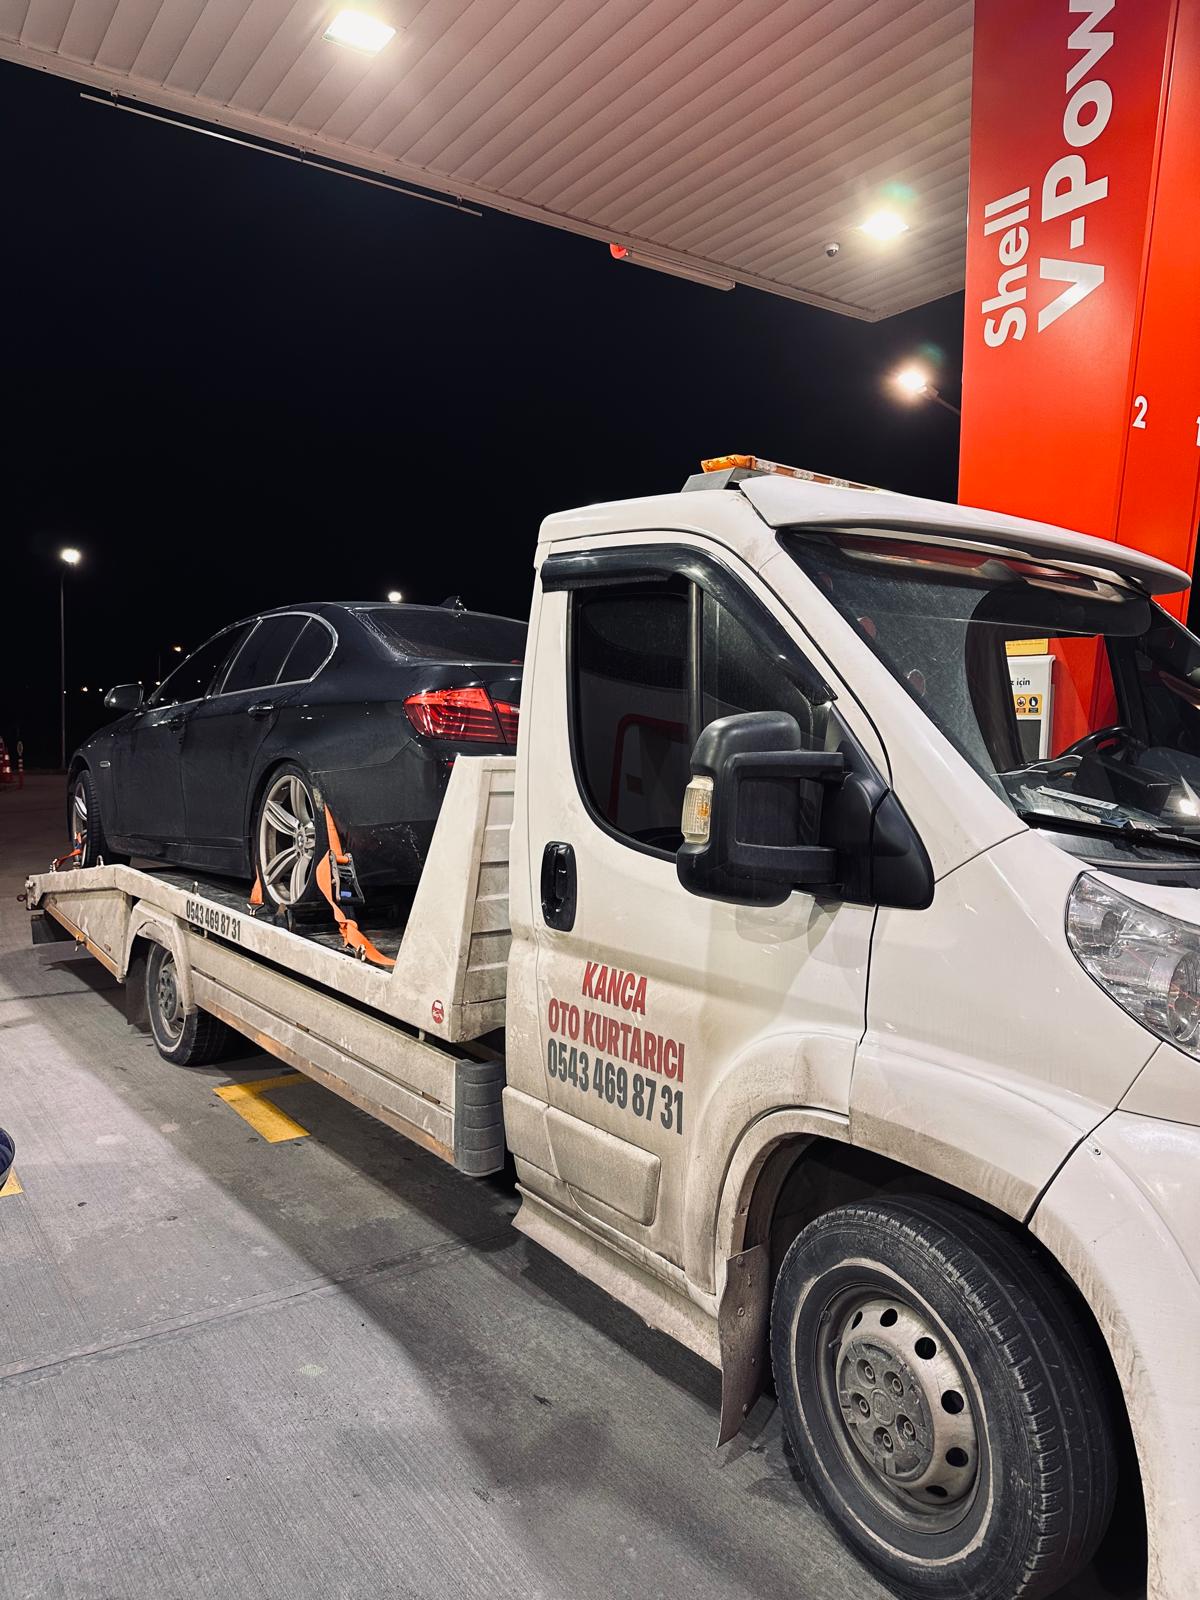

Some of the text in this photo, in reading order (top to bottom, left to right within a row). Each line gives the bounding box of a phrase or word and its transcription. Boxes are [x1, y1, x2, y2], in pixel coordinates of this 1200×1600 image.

[981, 186, 1030, 348] Shell
[1132, 395, 1148, 429] 2
[1016, 677, 1031, 688] için
[186, 900, 241, 941] 0543 469 87 31
[581, 961, 648, 1015] KANCA
[548, 998, 685, 1082] OTO KURTARICI
[547, 1038, 684, 1135] 0543 469 87 31
